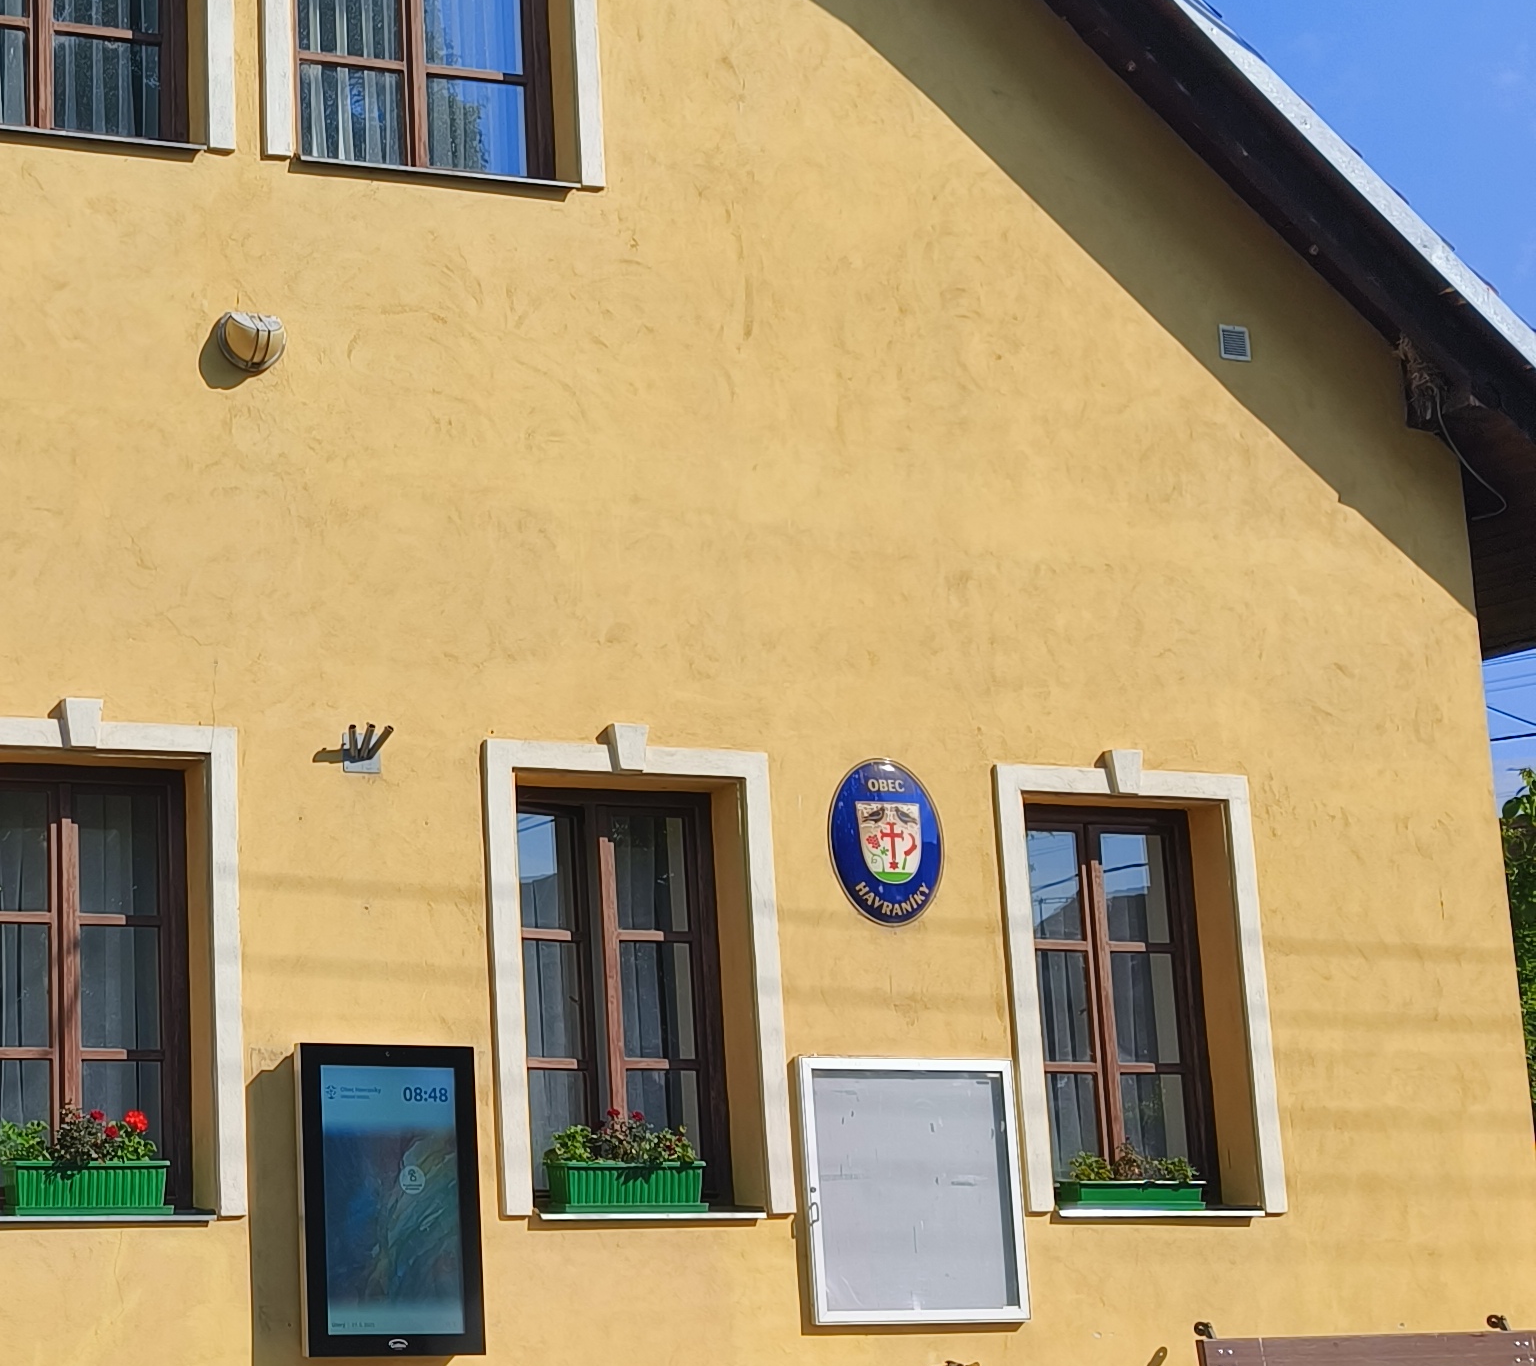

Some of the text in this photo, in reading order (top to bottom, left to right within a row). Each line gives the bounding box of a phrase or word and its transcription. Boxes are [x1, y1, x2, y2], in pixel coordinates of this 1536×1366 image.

[867, 778, 905, 792] OBEC
[855, 881, 930, 917] HAVRANÍKY
[402, 1086, 449, 1103] 08:48
